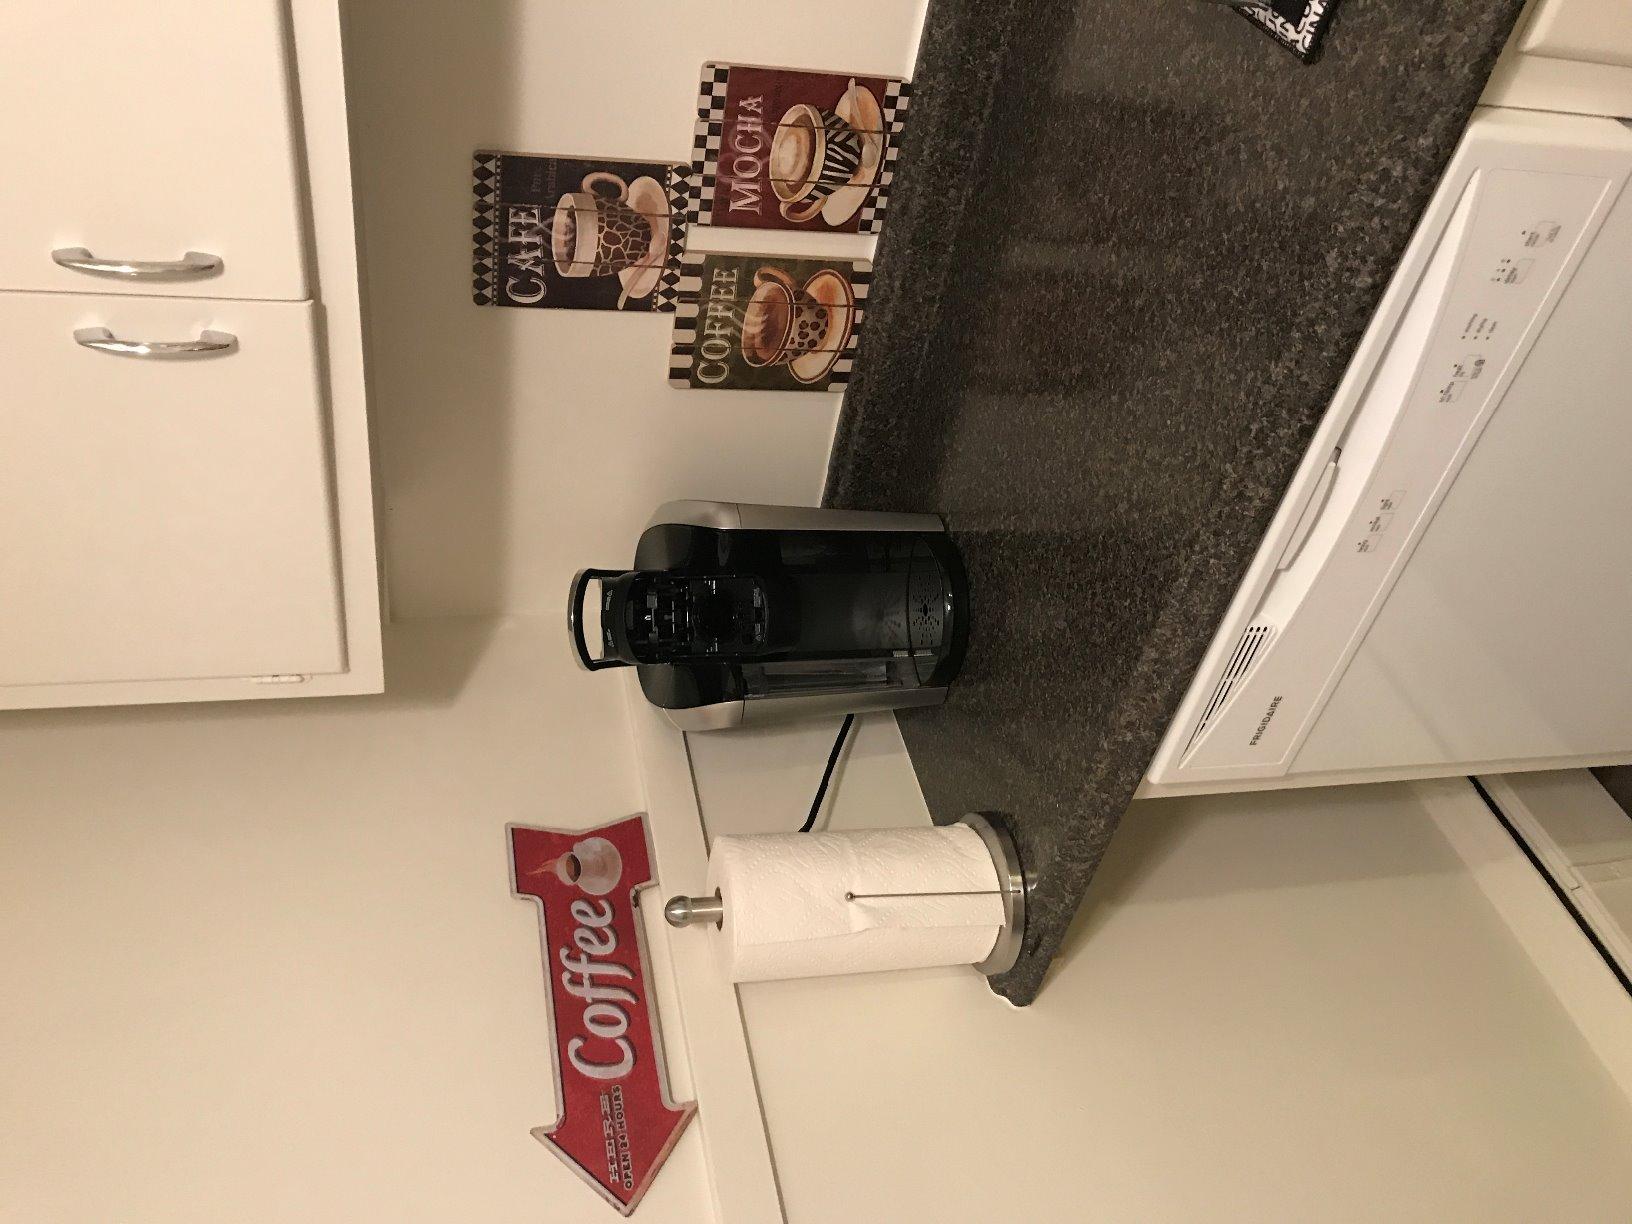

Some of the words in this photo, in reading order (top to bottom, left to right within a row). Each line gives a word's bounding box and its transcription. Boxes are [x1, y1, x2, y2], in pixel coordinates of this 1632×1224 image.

[728, 94, 765, 215] MOCHA
[505, 206, 547, 304] CAFE
[695, 267, 739, 385] COFFEE
[1249, 695, 1283, 746] FRIGIDAIRE
[560, 899, 638, 1078] Coffee
[600, 1092, 618, 1182] HERE
[613, 1085, 626, 1130] HOURS
[619, 1133, 629, 1149] 24
[621, 1151, 632, 1189] OPEN
